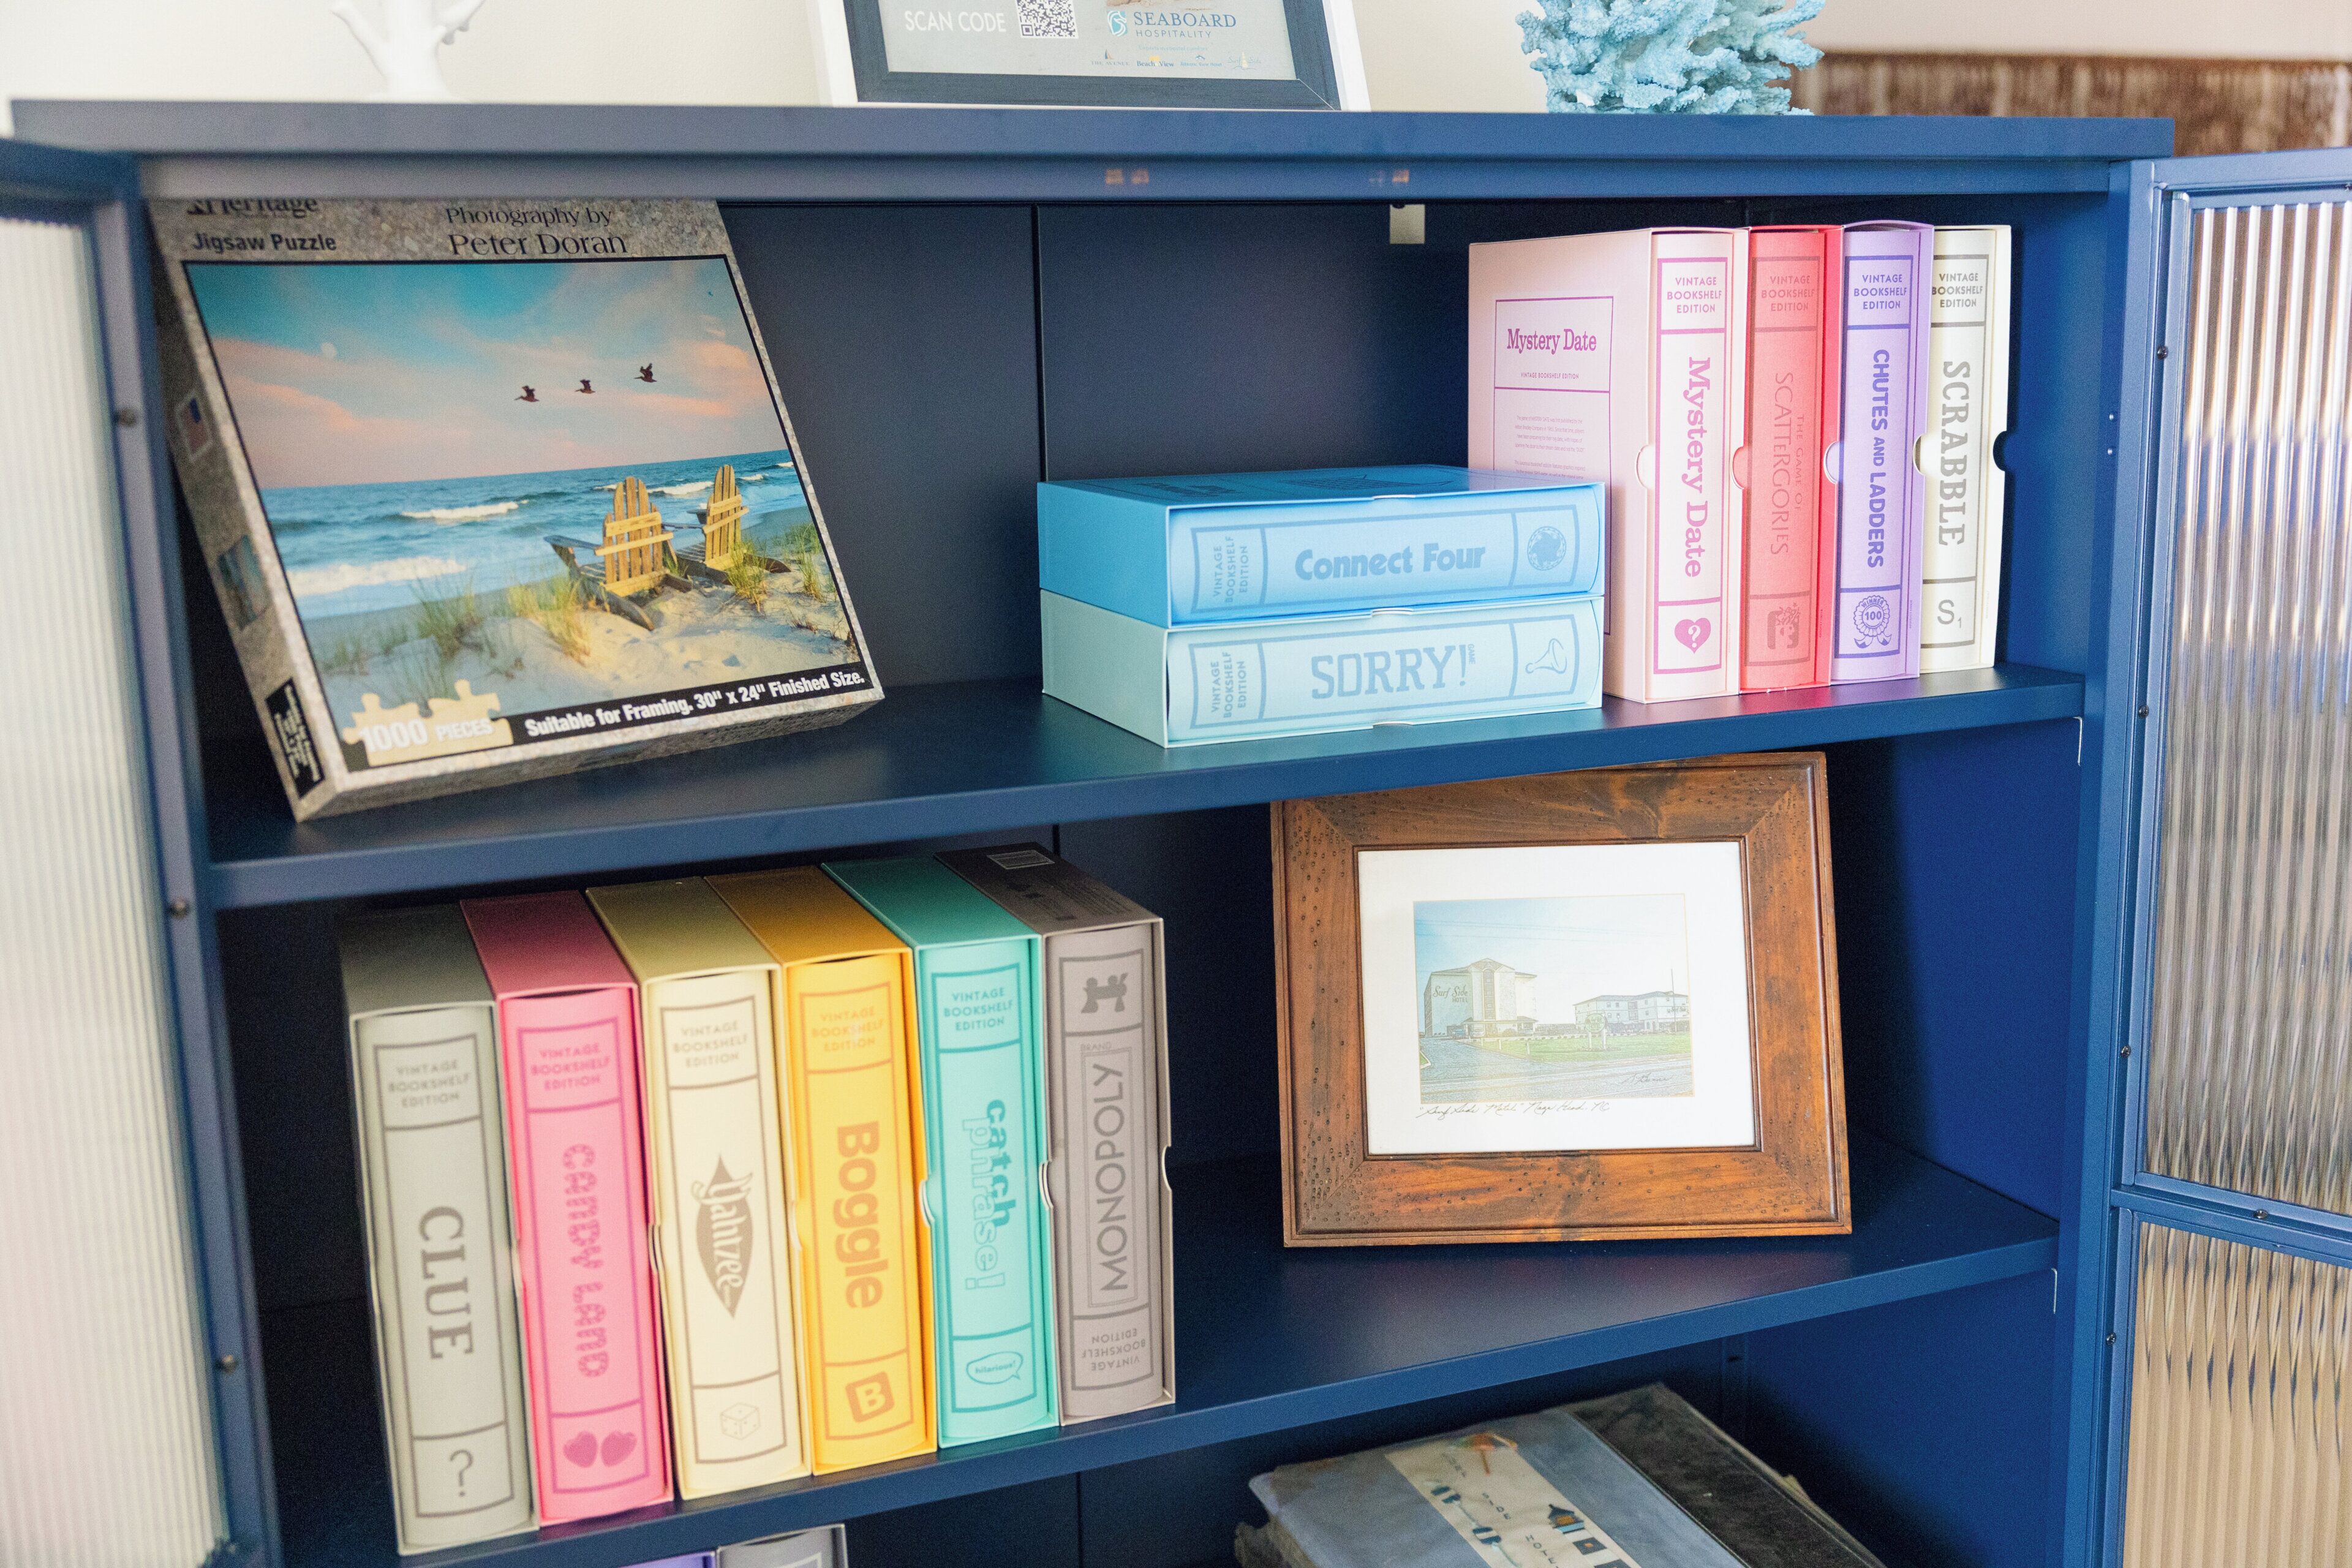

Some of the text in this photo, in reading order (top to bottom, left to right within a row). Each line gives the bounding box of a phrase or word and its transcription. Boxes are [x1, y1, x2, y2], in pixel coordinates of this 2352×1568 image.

[904, 10, 1005, 32] SCAN CODE
[1133, 12, 1236, 27] SEABOARD
[1136, 29, 1211, 38] HOSPITALITY
[446, 207, 612, 227] Photography by
[193, 233, 337, 254] Jigsaw Puzzle
[449, 233, 628, 255] Peter Doran
[1675, 276, 1717, 287] VINTAGE
[1770, 275, 1811, 285] VINTAGE
[1862, 274, 1902, 284] VINTAGE
[1939, 273, 1978, 283] VINTAGE
[1667, 290, 1722, 301] BOOKSHELF
[1761, 288, 1815, 299] BOOKSHELF
[1853, 286, 1907, 297] BOOKSHELF
[1931, 285, 1983, 296] BOOKSHELF
[1676, 304, 1716, 314] EDITION
[1771, 301, 1809, 312] EDITION
[1863, 300, 1901, 310] EDITION
[1940, 298, 1977, 309] EDITION
[1507, 328, 1596, 355] Mystery Date
[1868, 349, 1890, 568] CHUTES AND LADDERS
[1939, 361, 1971, 546] SCRABBLE
[1682, 356, 1710, 578] Mystery Date
[1771, 372, 1793, 555] SCATTERGORIES
[1795, 448, 1804, 486] GAME
[1795, 493, 1802, 509] OF
[1213, 545, 1223, 598] VINTAGE
[1225, 536, 1236, 603] BOOKSHELF
[1239, 545, 1248, 594] EDITION
[1295, 543, 1486, 581] Connect Four
[1861, 598, 1883, 608] WINNER
[1865, 611, 1882, 620] 100
[1311, 644, 1466, 699] SORRY!
[1211, 662, 1220, 713] VINTAGE
[1223, 651, 1234, 718] BOOKSHELF
[1237, 661, 1247, 709] EDITION
[524, 670, 865, 737] Suitable for Framing. 30" x 24" Finished Size.
[358, 718, 494, 752] 1000 PIECES
[952, 987, 1004, 1001] VINTAGE
[1433, 984, 1468, 999] Surf Side
[820, 1006, 874, 1021] VINTAGE
[944, 1000, 1012, 1017] BOOKSHELF
[680, 1020, 738, 1036] VINTAGE
[956, 1016, 1004, 1031] EDITION
[540, 1042, 598, 1058] VINTAGE
[674, 1033, 747, 1053] BOOKSHELF
[824, 1037, 875, 1052] EDITION
[396, 1060, 457, 1074] VINTAGE
[531, 1055, 610, 1076] BOOKSHELF
[686, 1052, 739, 1068] EDITION
[388, 1073, 469, 1092] BOOKSHELF
[545, 1076, 600, 1090] EDITION
[401, 1093, 460, 1108] EDITION
[987, 1099, 1016, 1227] catch
[1093, 1063, 1128, 1291] MONOPOLY
[962, 1117, 1005, 1289] phrase!
[833, 1120, 889, 1308] Boggle
[691, 1172, 753, 1294] Yahtzee
[418, 1205, 474, 1361] CLUE
[1091, 1328, 1137, 1344] EDITION
[1082, 1339, 1145, 1358] BOOKSHELF
[1091, 1355, 1139, 1371] VINTAGE
[856, 1382, 886, 1414] B
[1482, 1492, 1511, 1520] SIDE
[1525, 1534, 1559, 1568] HOTE
